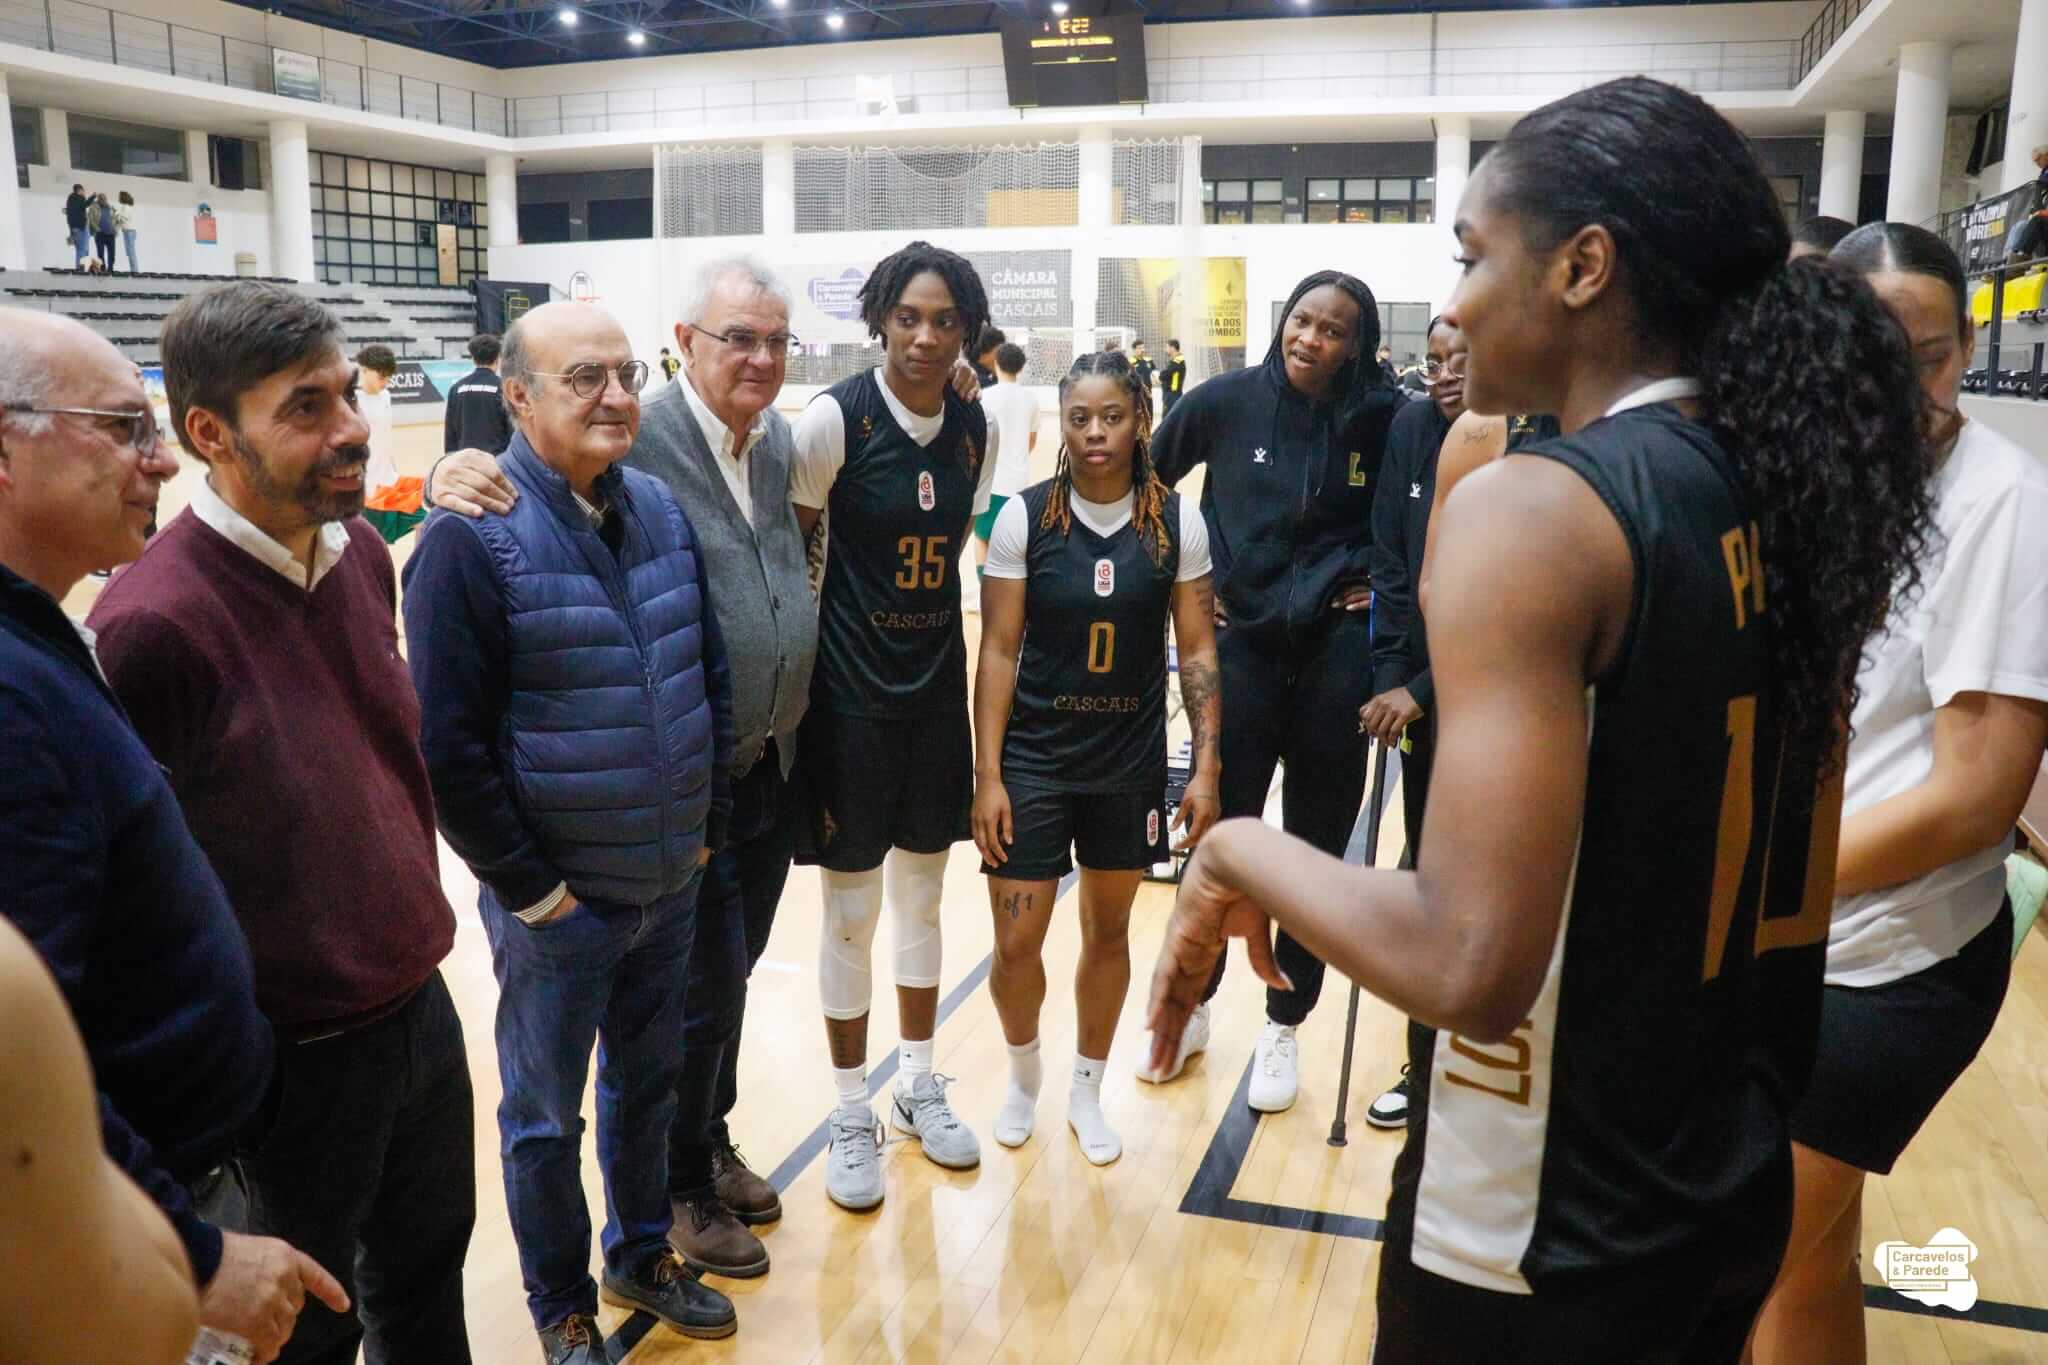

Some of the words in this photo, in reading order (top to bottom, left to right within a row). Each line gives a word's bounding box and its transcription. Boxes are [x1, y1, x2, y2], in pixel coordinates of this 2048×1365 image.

[992, 268, 1057, 285] CÂMARA
[992, 288, 1057, 299] MUNICIPAL
[992, 304, 1057, 316] CASCAIS
[1205, 328, 1241, 336] OMBOS
[896, 536, 948, 589] 35
[1088, 622, 1115, 673] 0
[1053, 695, 1139, 712] CASCAIS
